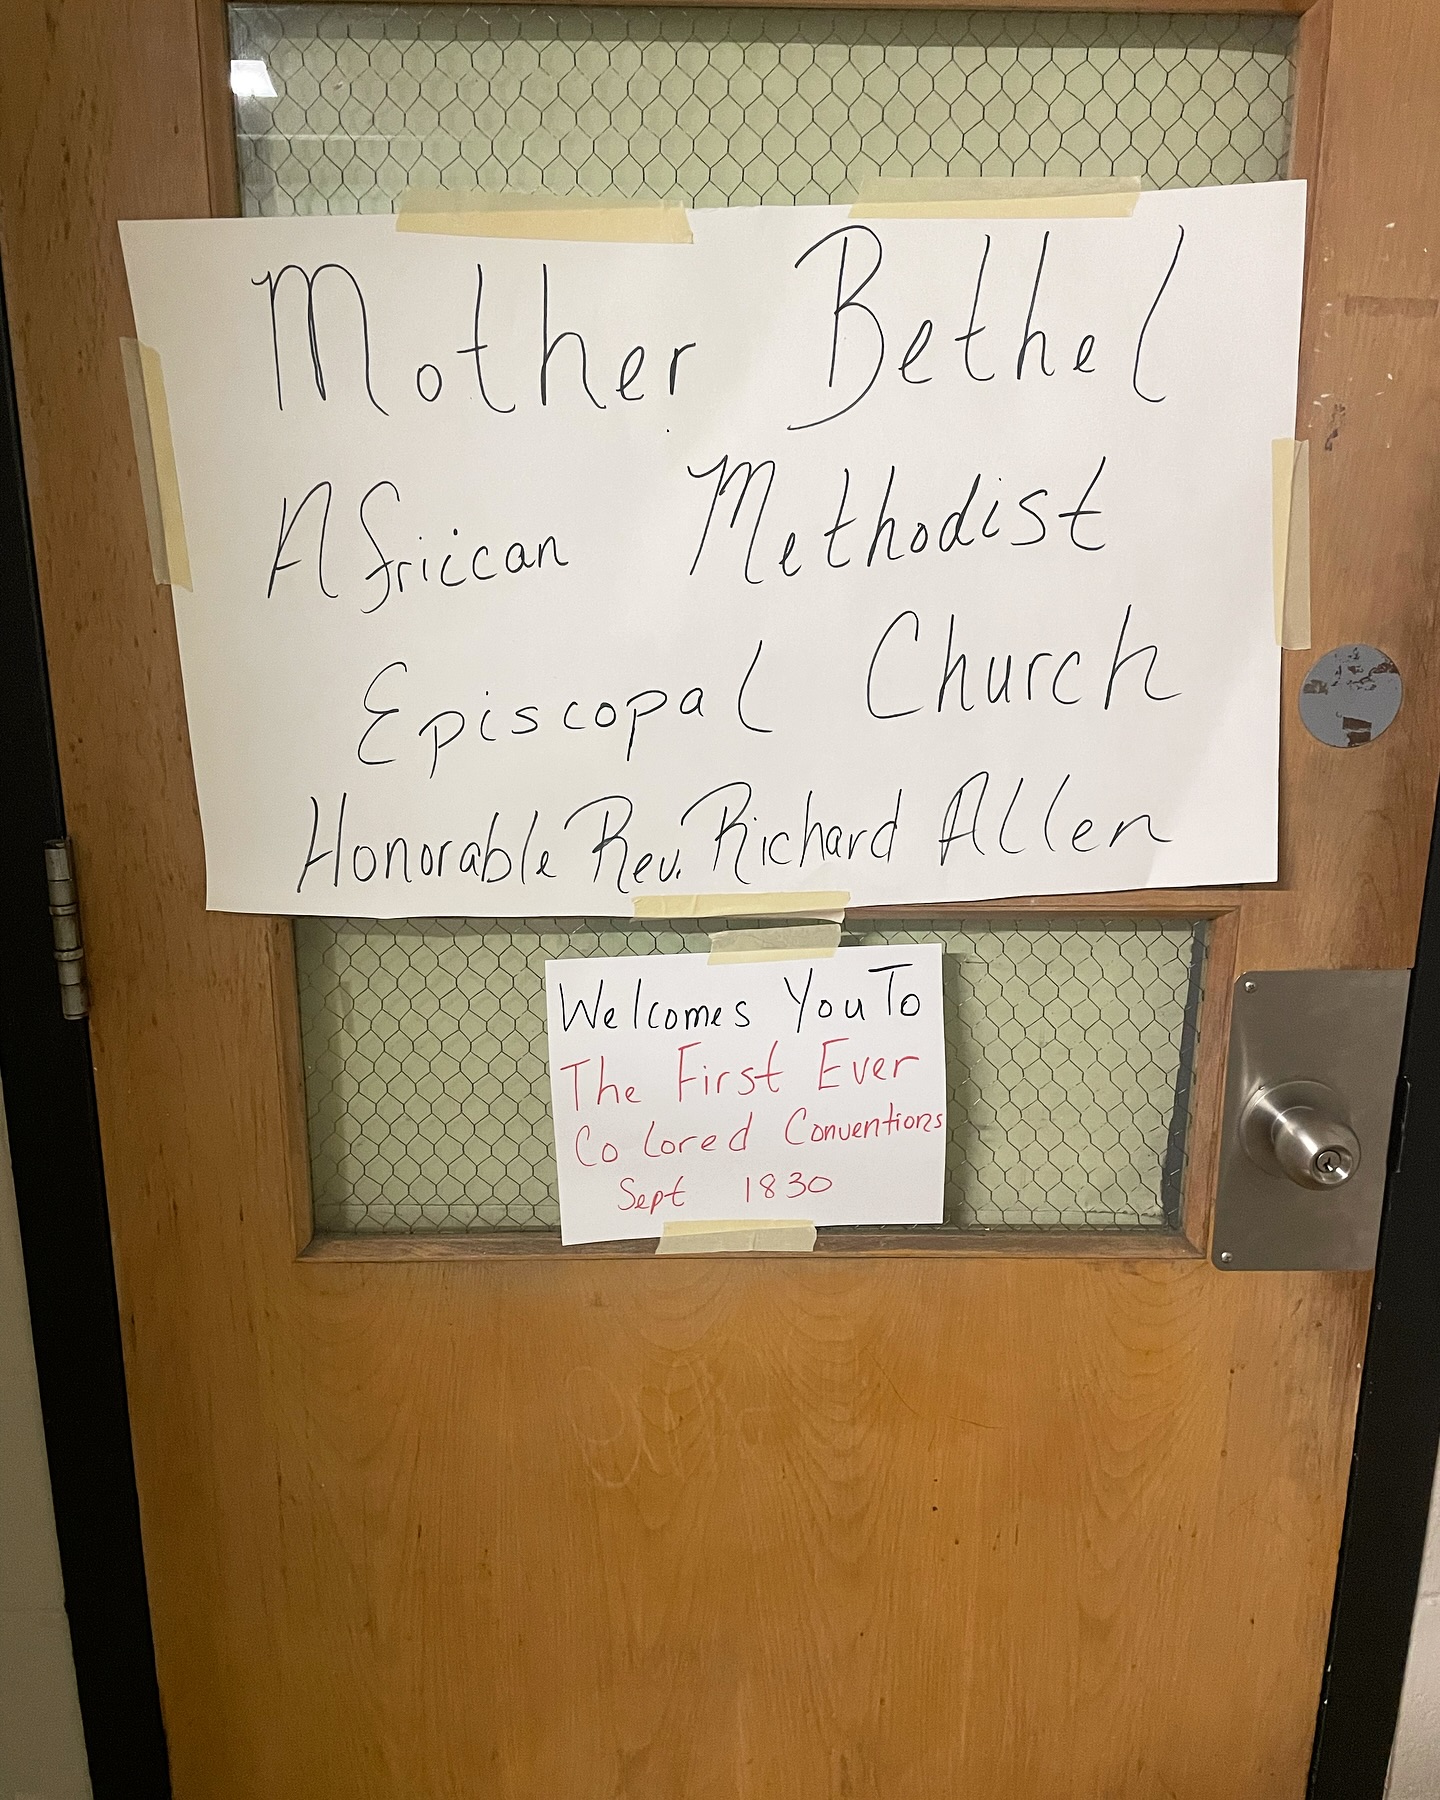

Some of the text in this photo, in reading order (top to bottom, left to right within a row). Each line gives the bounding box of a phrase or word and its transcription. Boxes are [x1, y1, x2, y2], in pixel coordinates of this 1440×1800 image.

[251, 225, 1185, 431] Mother Bethel
[687, 454, 1107, 586] Methodist
[357, 604, 1183, 779] Episcopal Church
[297, 770, 1174, 894] Honorable Rev. Richard Allen
[559, 963, 921, 1034] Welcomes You To
[560, 1037, 920, 1111] The First Ever
[784, 1101, 944, 1147] Conventions
[617, 1171, 834, 1216] Sept 1830
